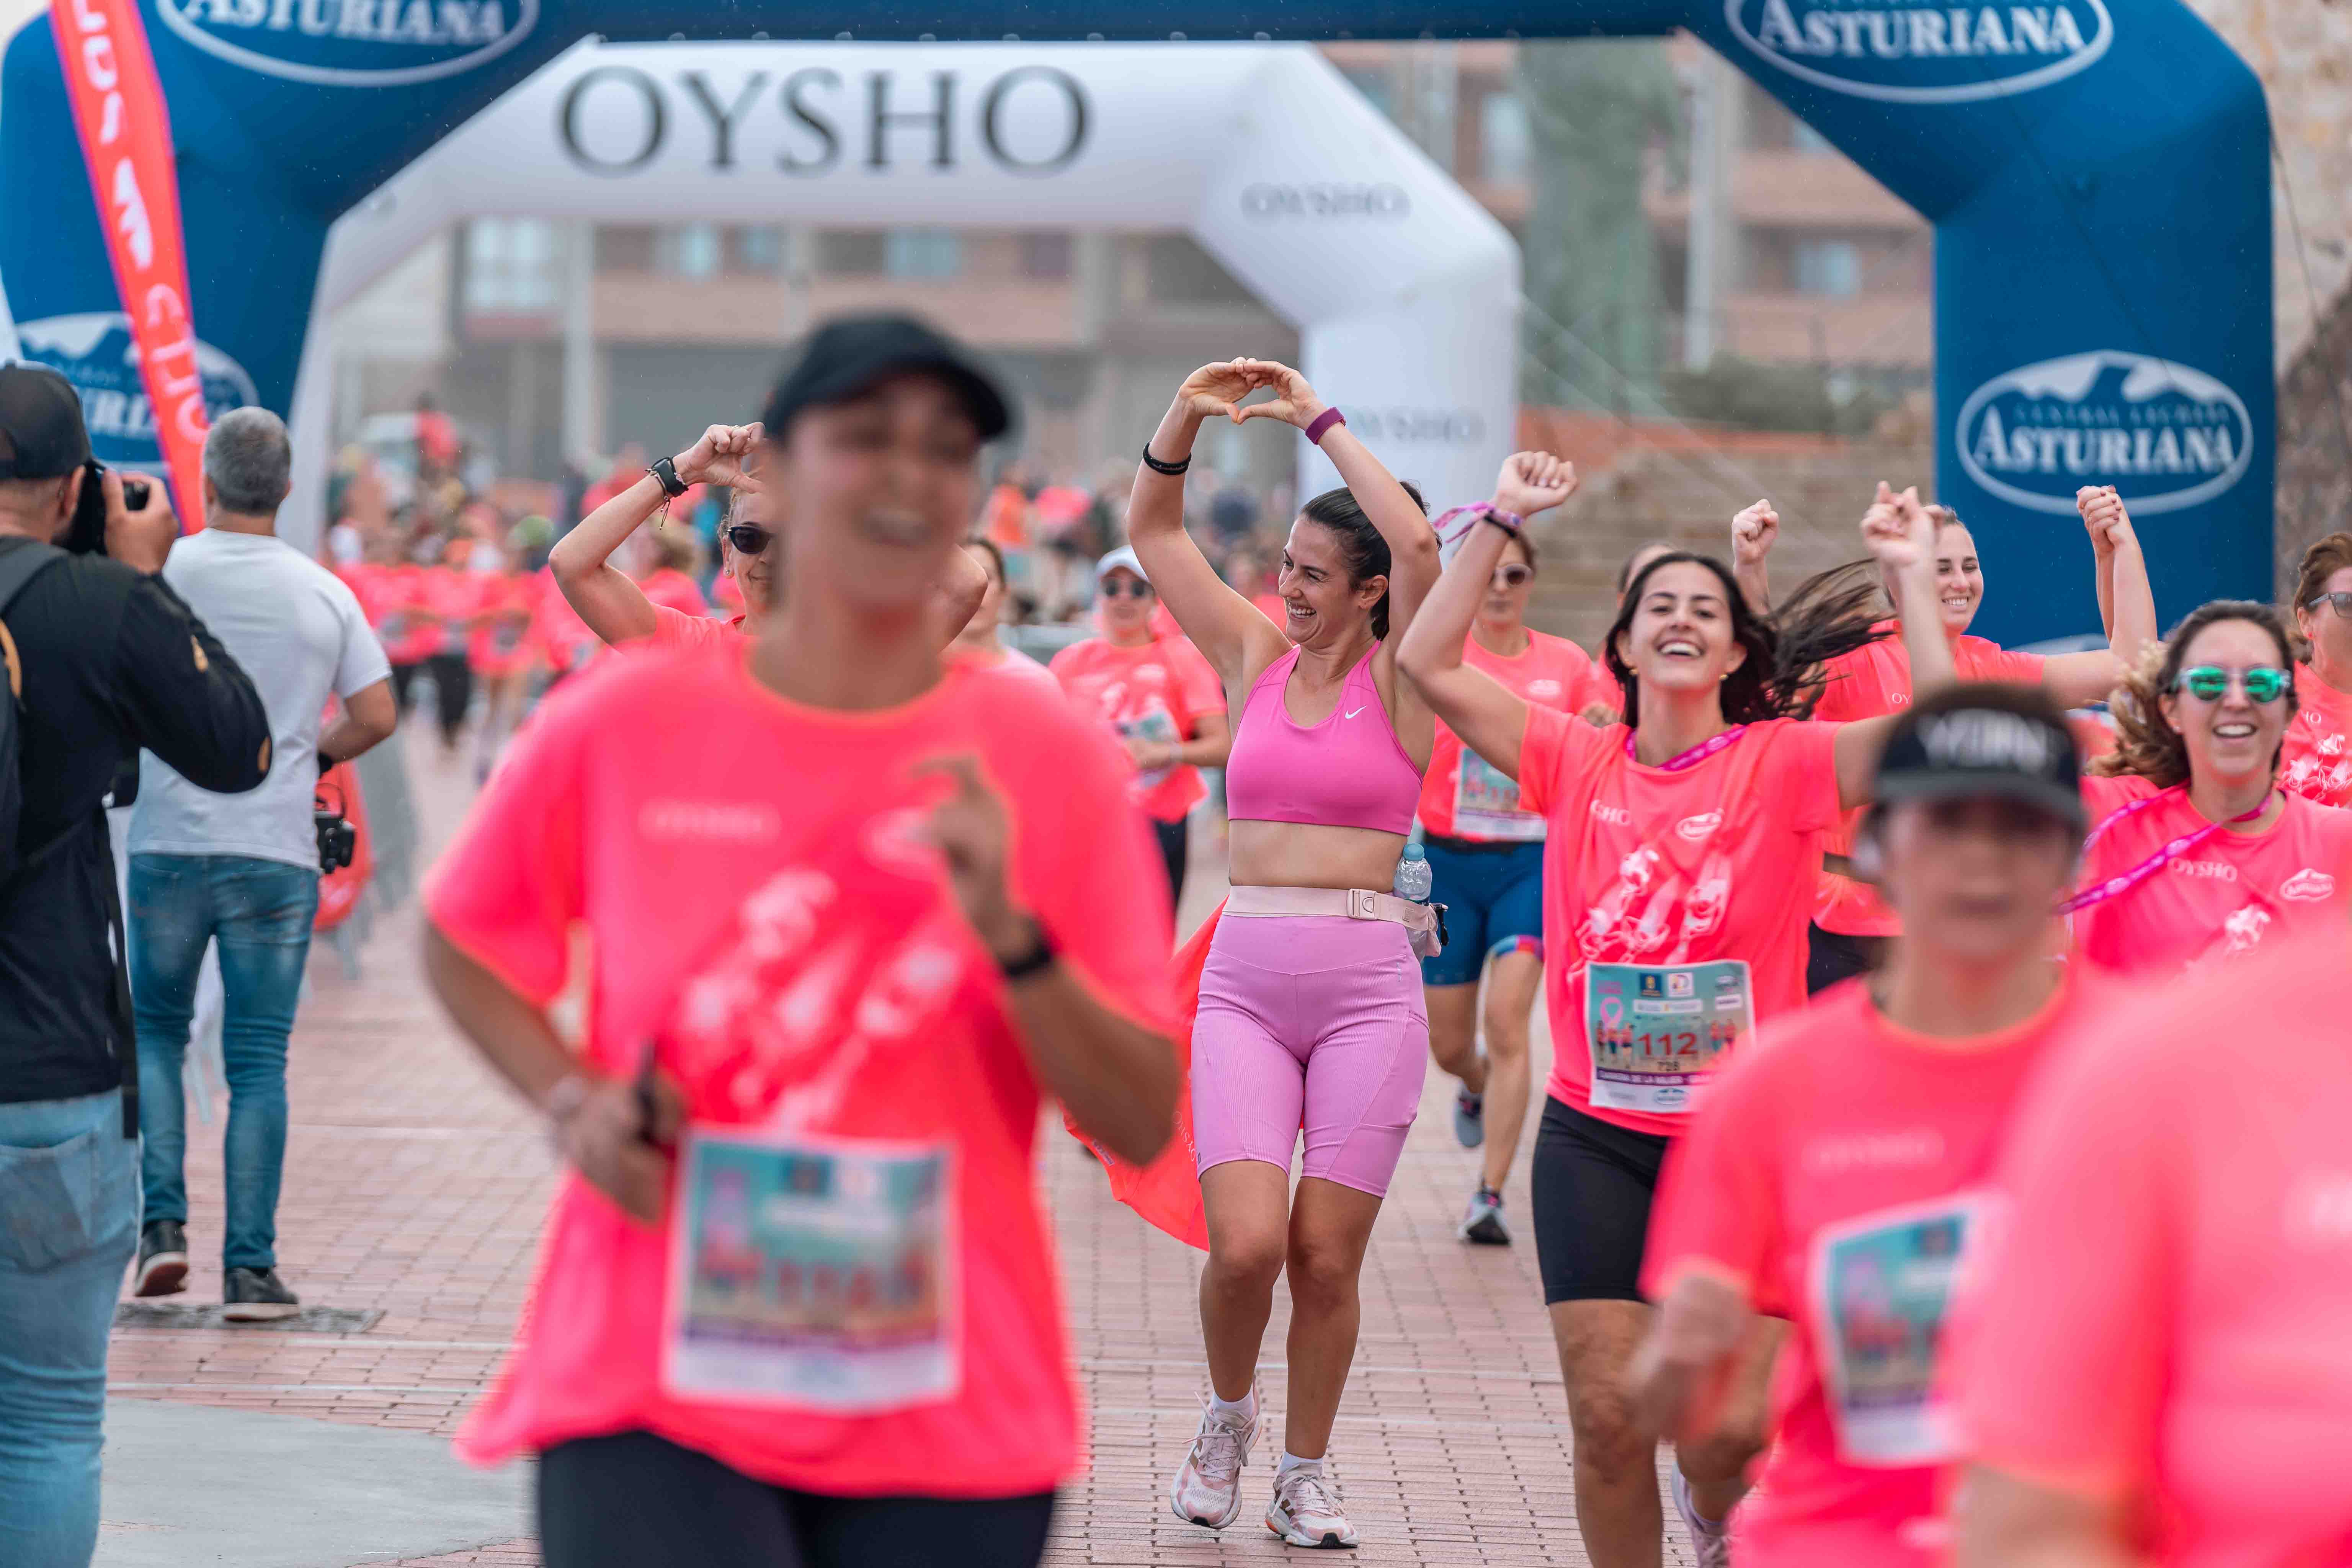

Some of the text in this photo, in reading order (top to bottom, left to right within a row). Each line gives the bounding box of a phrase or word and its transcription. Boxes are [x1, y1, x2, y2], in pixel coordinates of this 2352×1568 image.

[180, 0, 507, 45] STURIANA
[1758, 0, 2087, 58] ASTURIANA
[556, 65, 1093, 176] OYSHO
[1971, 404, 2236, 475] ASTURIANA
[2167, 857, 2238, 883] OYSHO
[1638, 1032, 1698, 1056] 112
